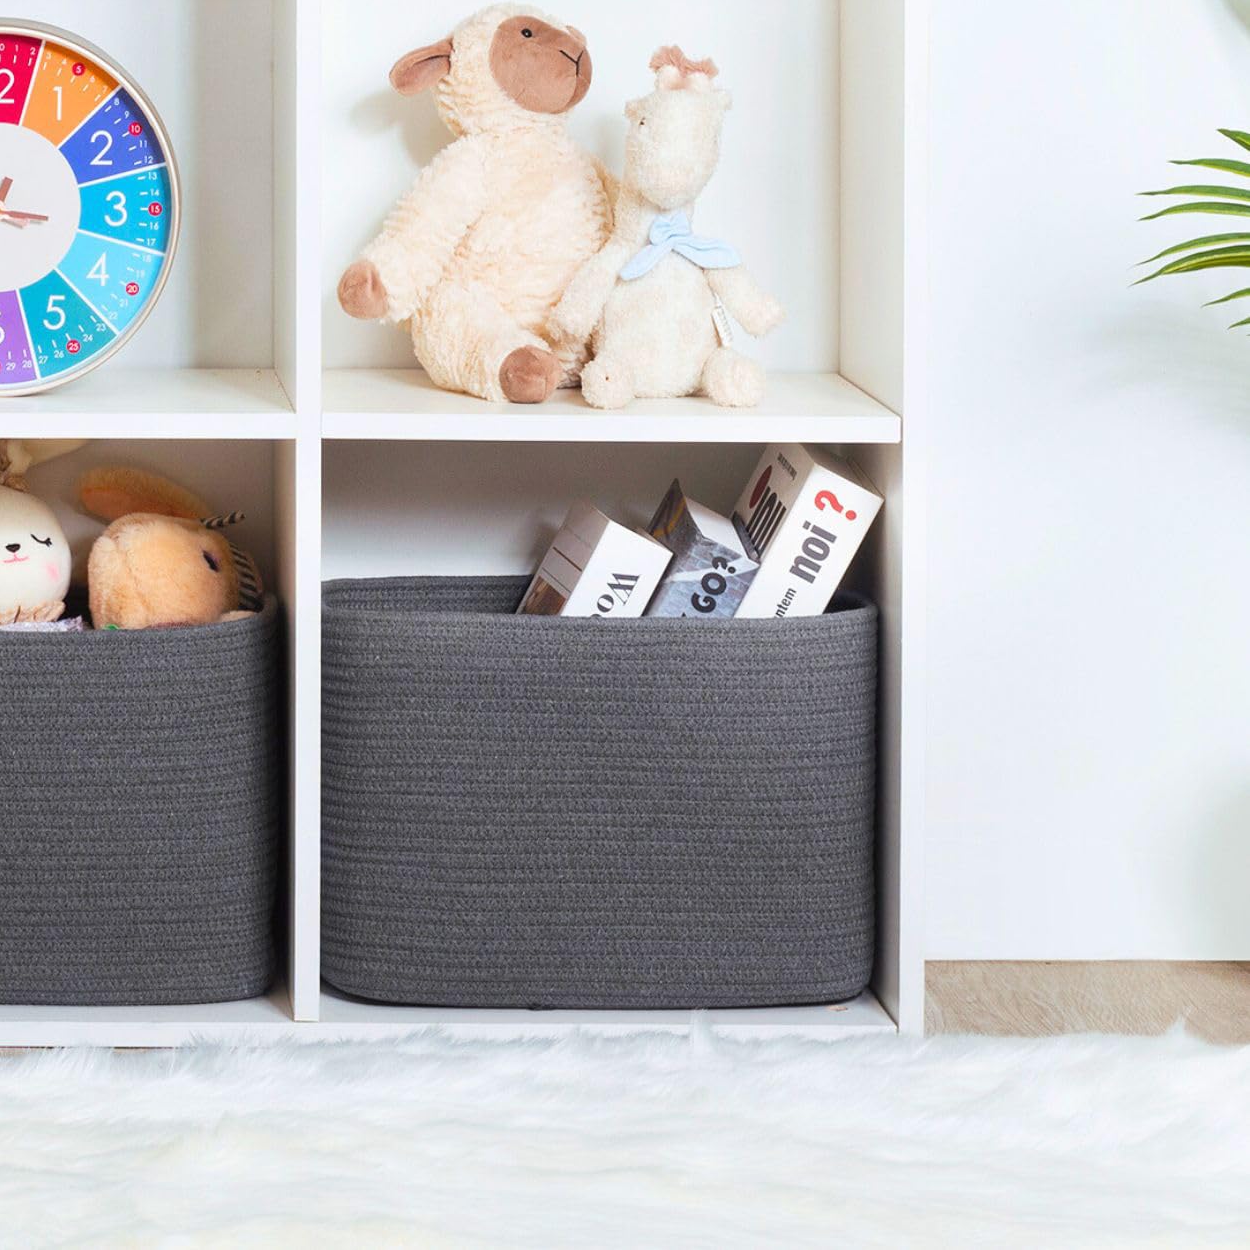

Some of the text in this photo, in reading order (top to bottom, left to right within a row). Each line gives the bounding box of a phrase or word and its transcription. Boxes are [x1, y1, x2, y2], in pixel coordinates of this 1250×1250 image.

[53, 86, 63, 121] 1
[89, 130, 113, 166] 2
[104, 191, 128, 227] 3
[86, 252, 110, 287] 4
[42, 295, 66, 330] 5
[789, 489, 857, 584] noi ?
[591, 573, 641, 618] Wo
[691, 556, 737, 614] GO?
[774, 588, 797, 618] ntem
